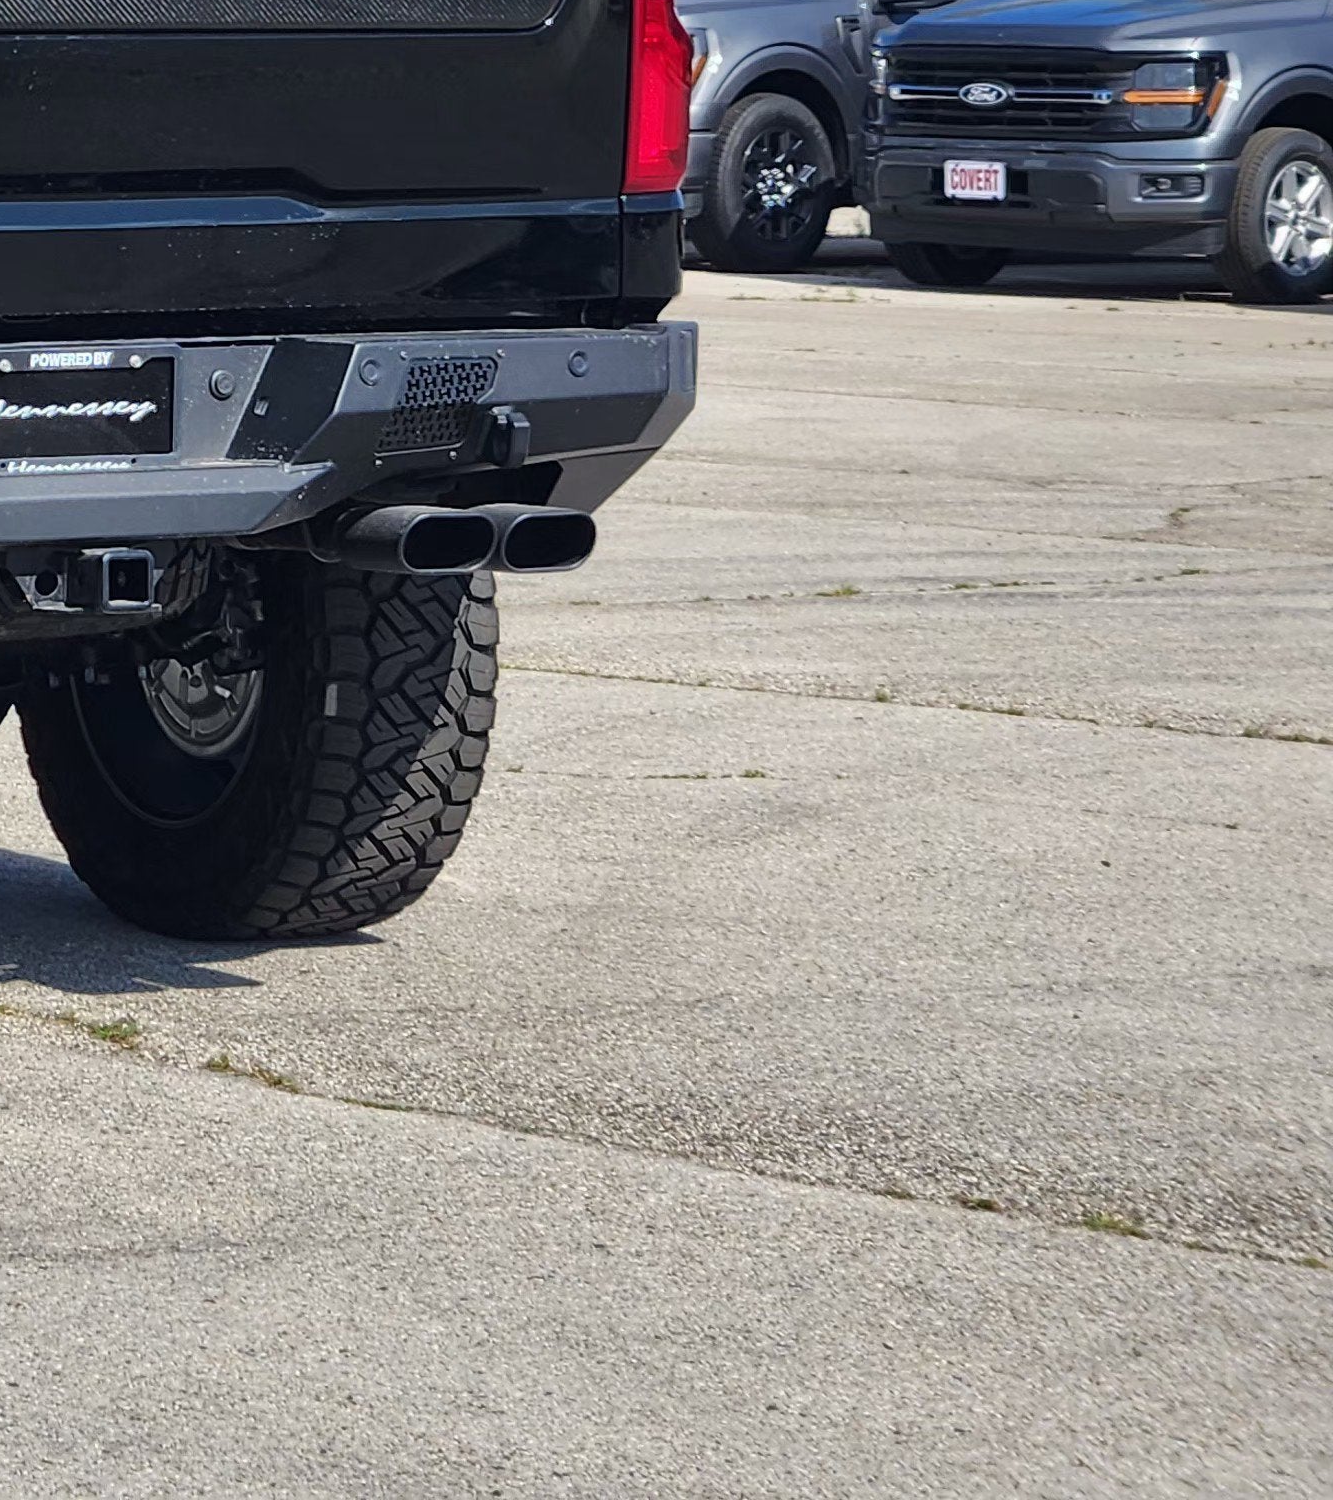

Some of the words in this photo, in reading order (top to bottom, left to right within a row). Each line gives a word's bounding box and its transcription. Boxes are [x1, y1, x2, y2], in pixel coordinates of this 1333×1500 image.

[950, 168, 1000, 191] COVERT
[29, 353, 92, 368] POWERED
[93, 350, 114, 366] BY
